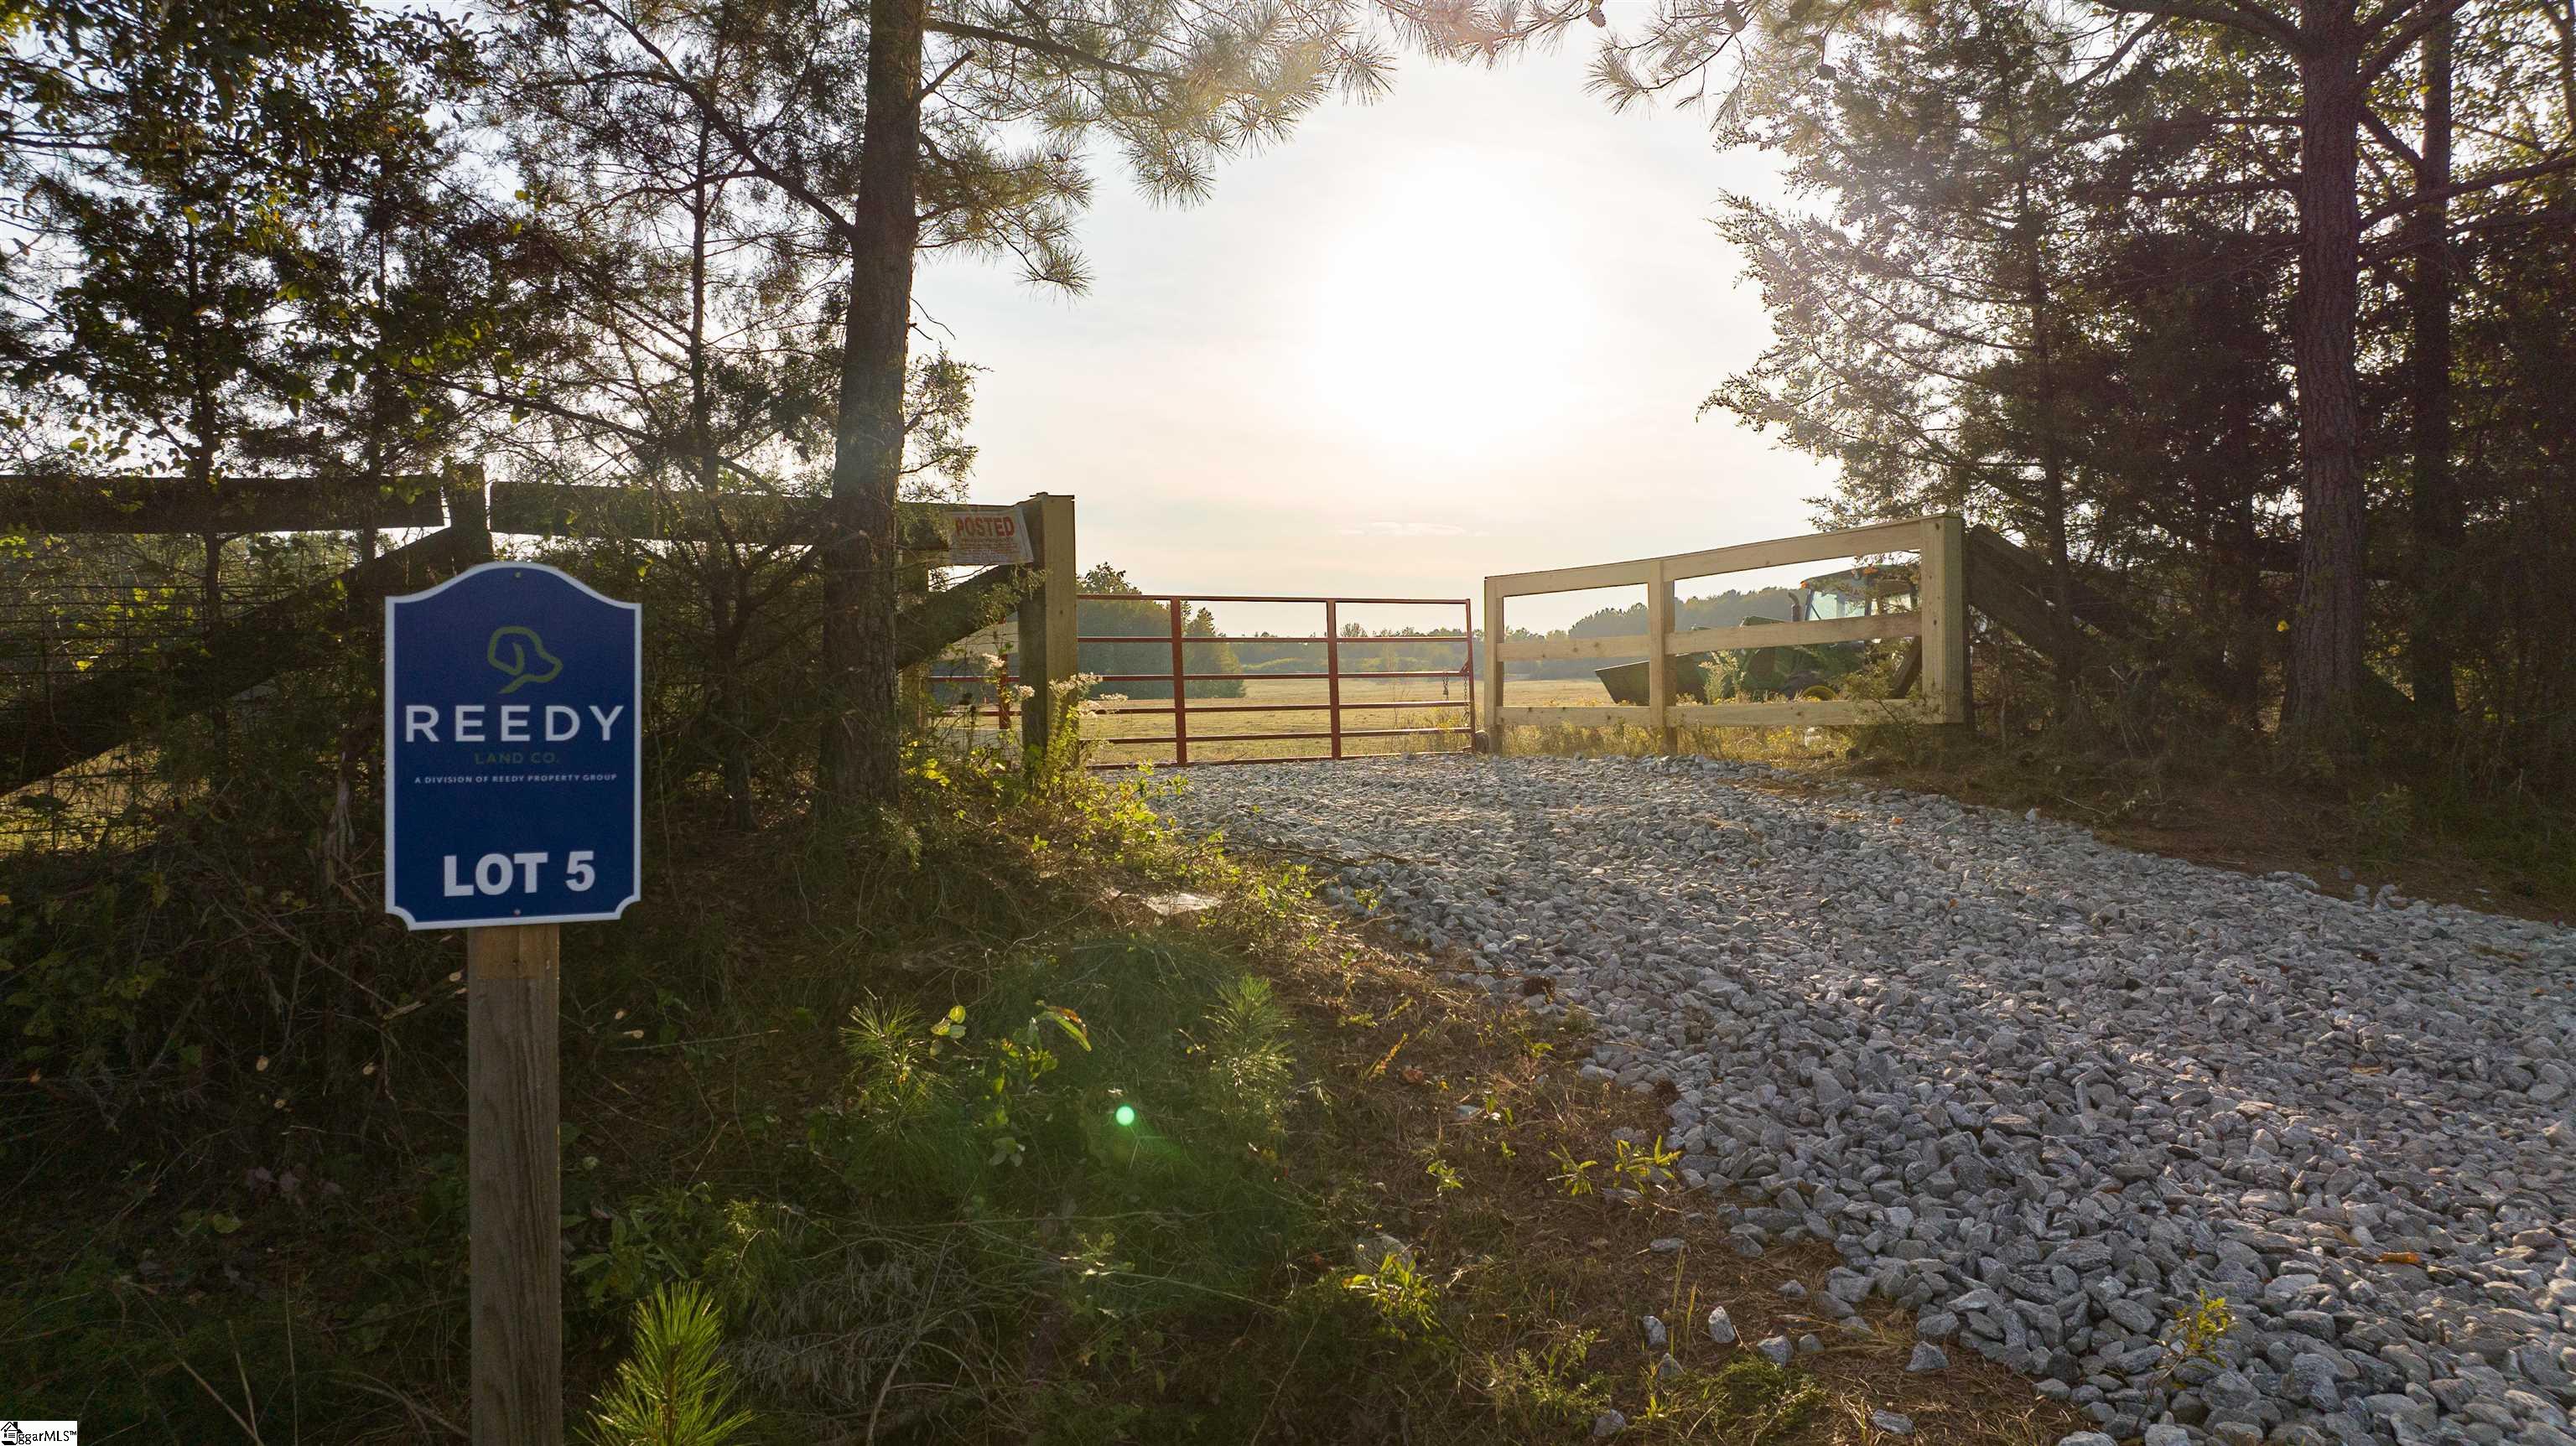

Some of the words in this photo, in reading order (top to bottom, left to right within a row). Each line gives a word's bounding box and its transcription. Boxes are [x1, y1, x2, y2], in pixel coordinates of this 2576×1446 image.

[955, 516, 1015, 537] POSTED
[406, 705, 624, 743] REEDY
[475, 752, 524, 764] LAND
[531, 752, 561, 764] CO.
[424, 775, 473, 784] DIVISION
[492, 775, 525, 783] REEDY
[527, 774, 580, 782] PROPERTY
[583, 773, 618, 781] GROUP
[444, 852, 548, 897] LOT
[565, 850, 595, 892] 5
